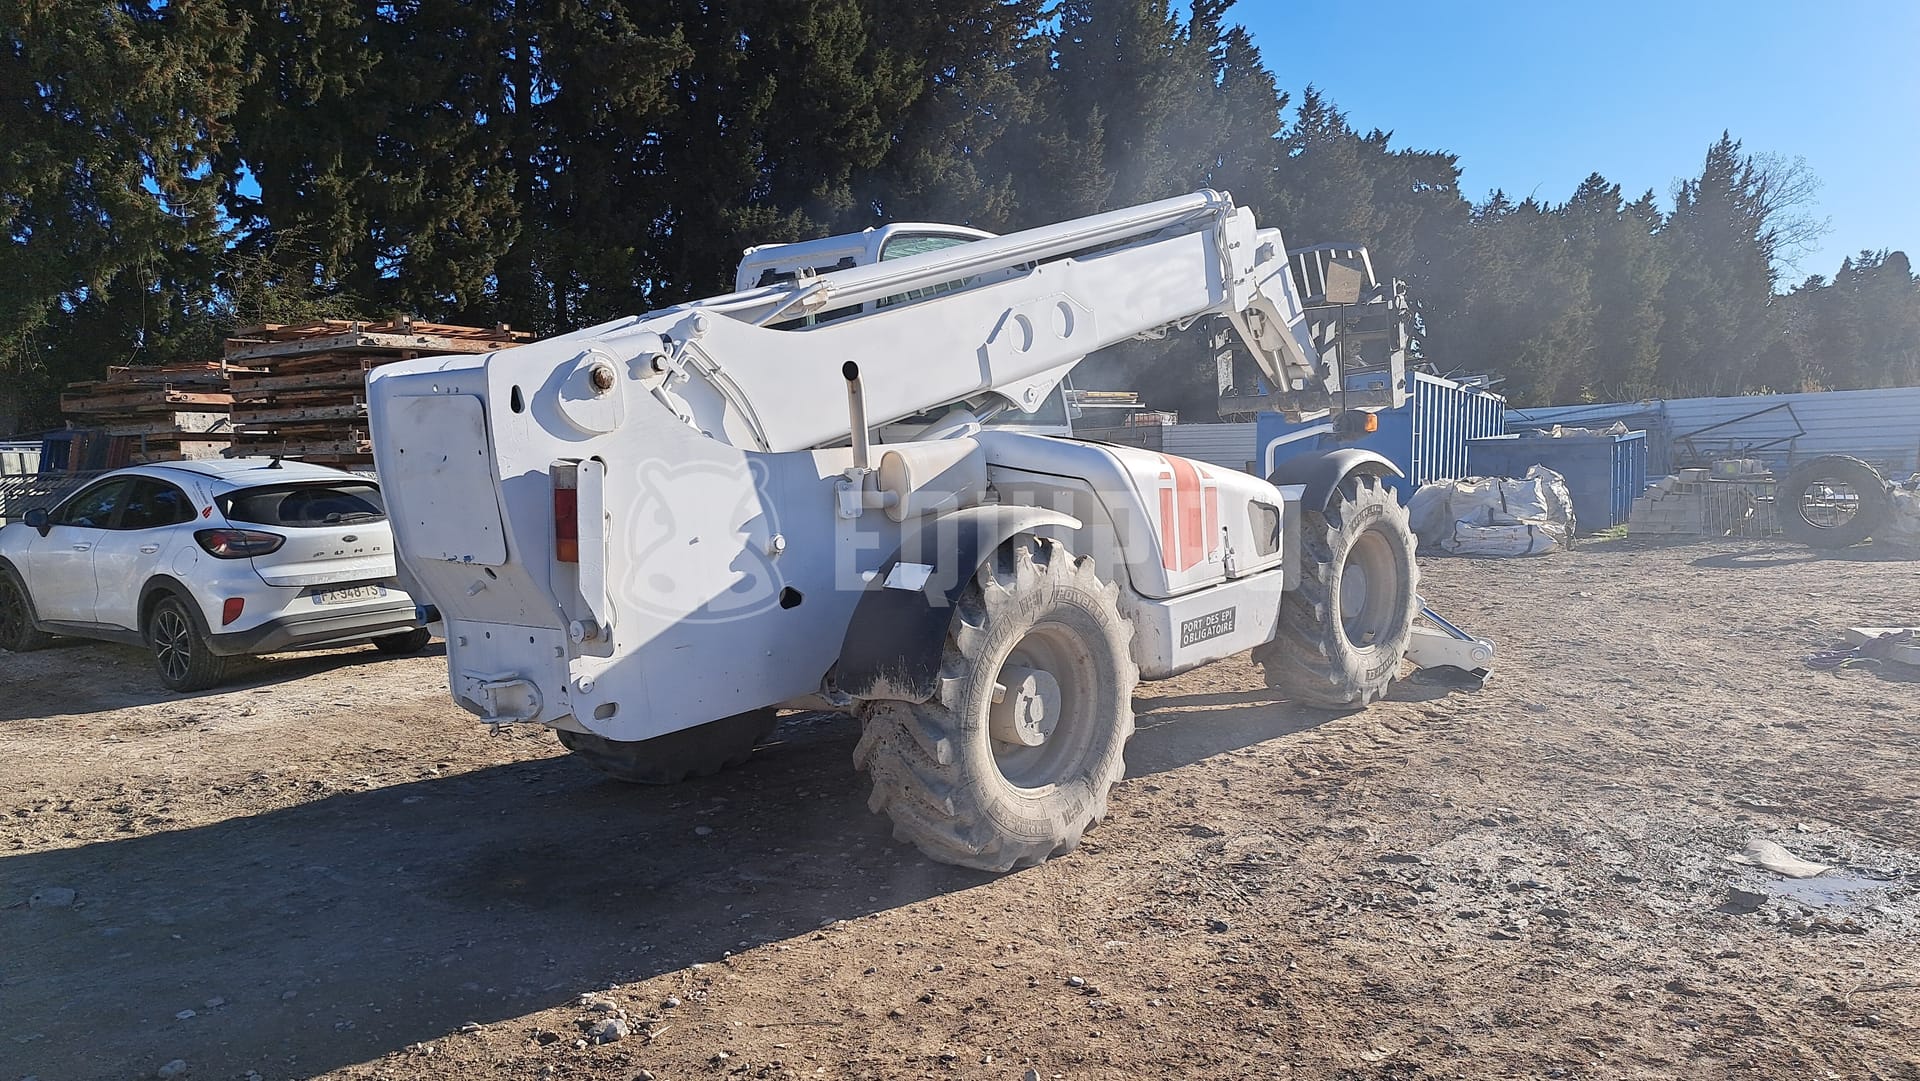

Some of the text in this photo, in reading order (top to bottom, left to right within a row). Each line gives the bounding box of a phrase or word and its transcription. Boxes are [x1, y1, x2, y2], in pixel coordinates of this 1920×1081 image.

[1184, 610, 1232, 633] PORT DES EPI
[1184, 620, 1233, 645] OBLIGATOIRE
